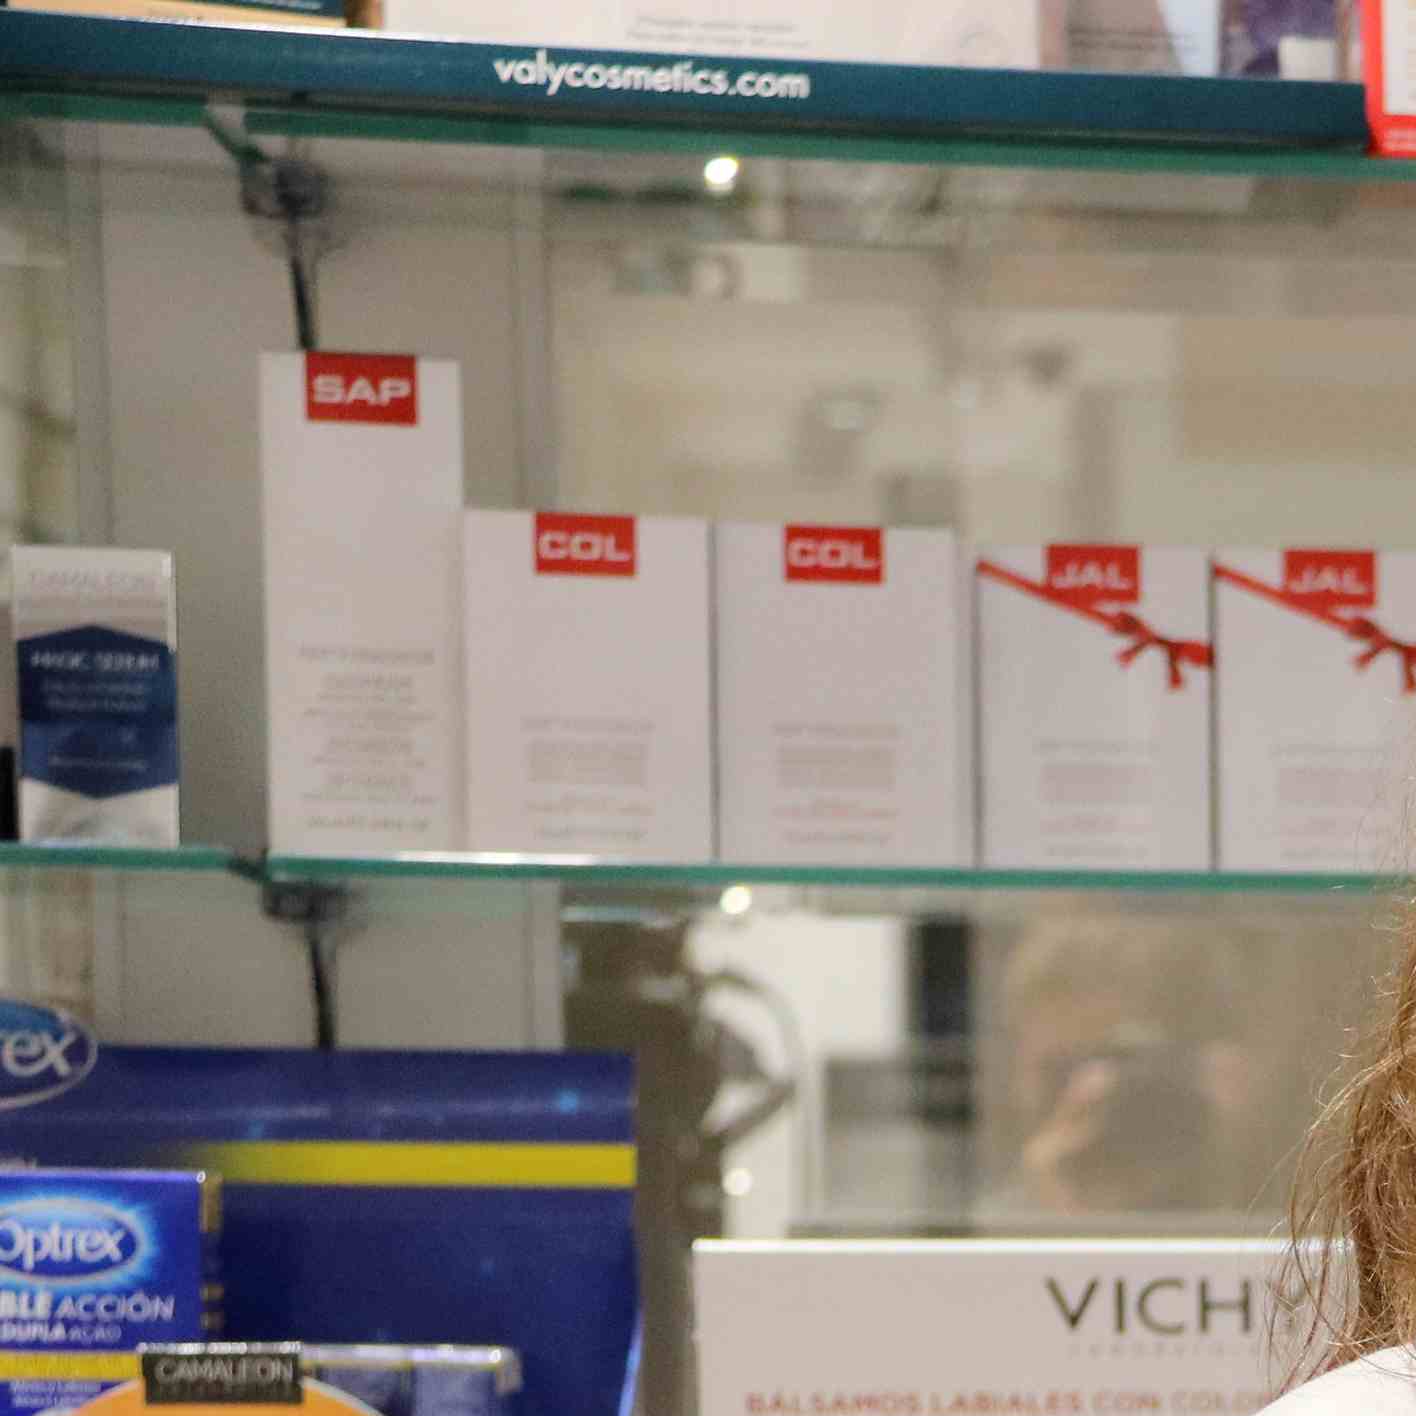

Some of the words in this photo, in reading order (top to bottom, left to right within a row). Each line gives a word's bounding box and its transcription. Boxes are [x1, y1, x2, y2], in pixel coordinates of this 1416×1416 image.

[494, 50, 811, 97] valycosmetics.com
[312, 376, 411, 405] SAP
[539, 532, 632, 562] COL
[787, 539, 875, 568] COL
[1053, 565, 1133, 591] JAL
[1289, 566, 1371, 594] JAL
[0, 1218, 127, 1270] Optrex
[57, 1290, 175, 1322] ACCIÓN
[928, 1391, 1081, 1416] LABIALES
[1092, 1392, 1161, 1416] CON
